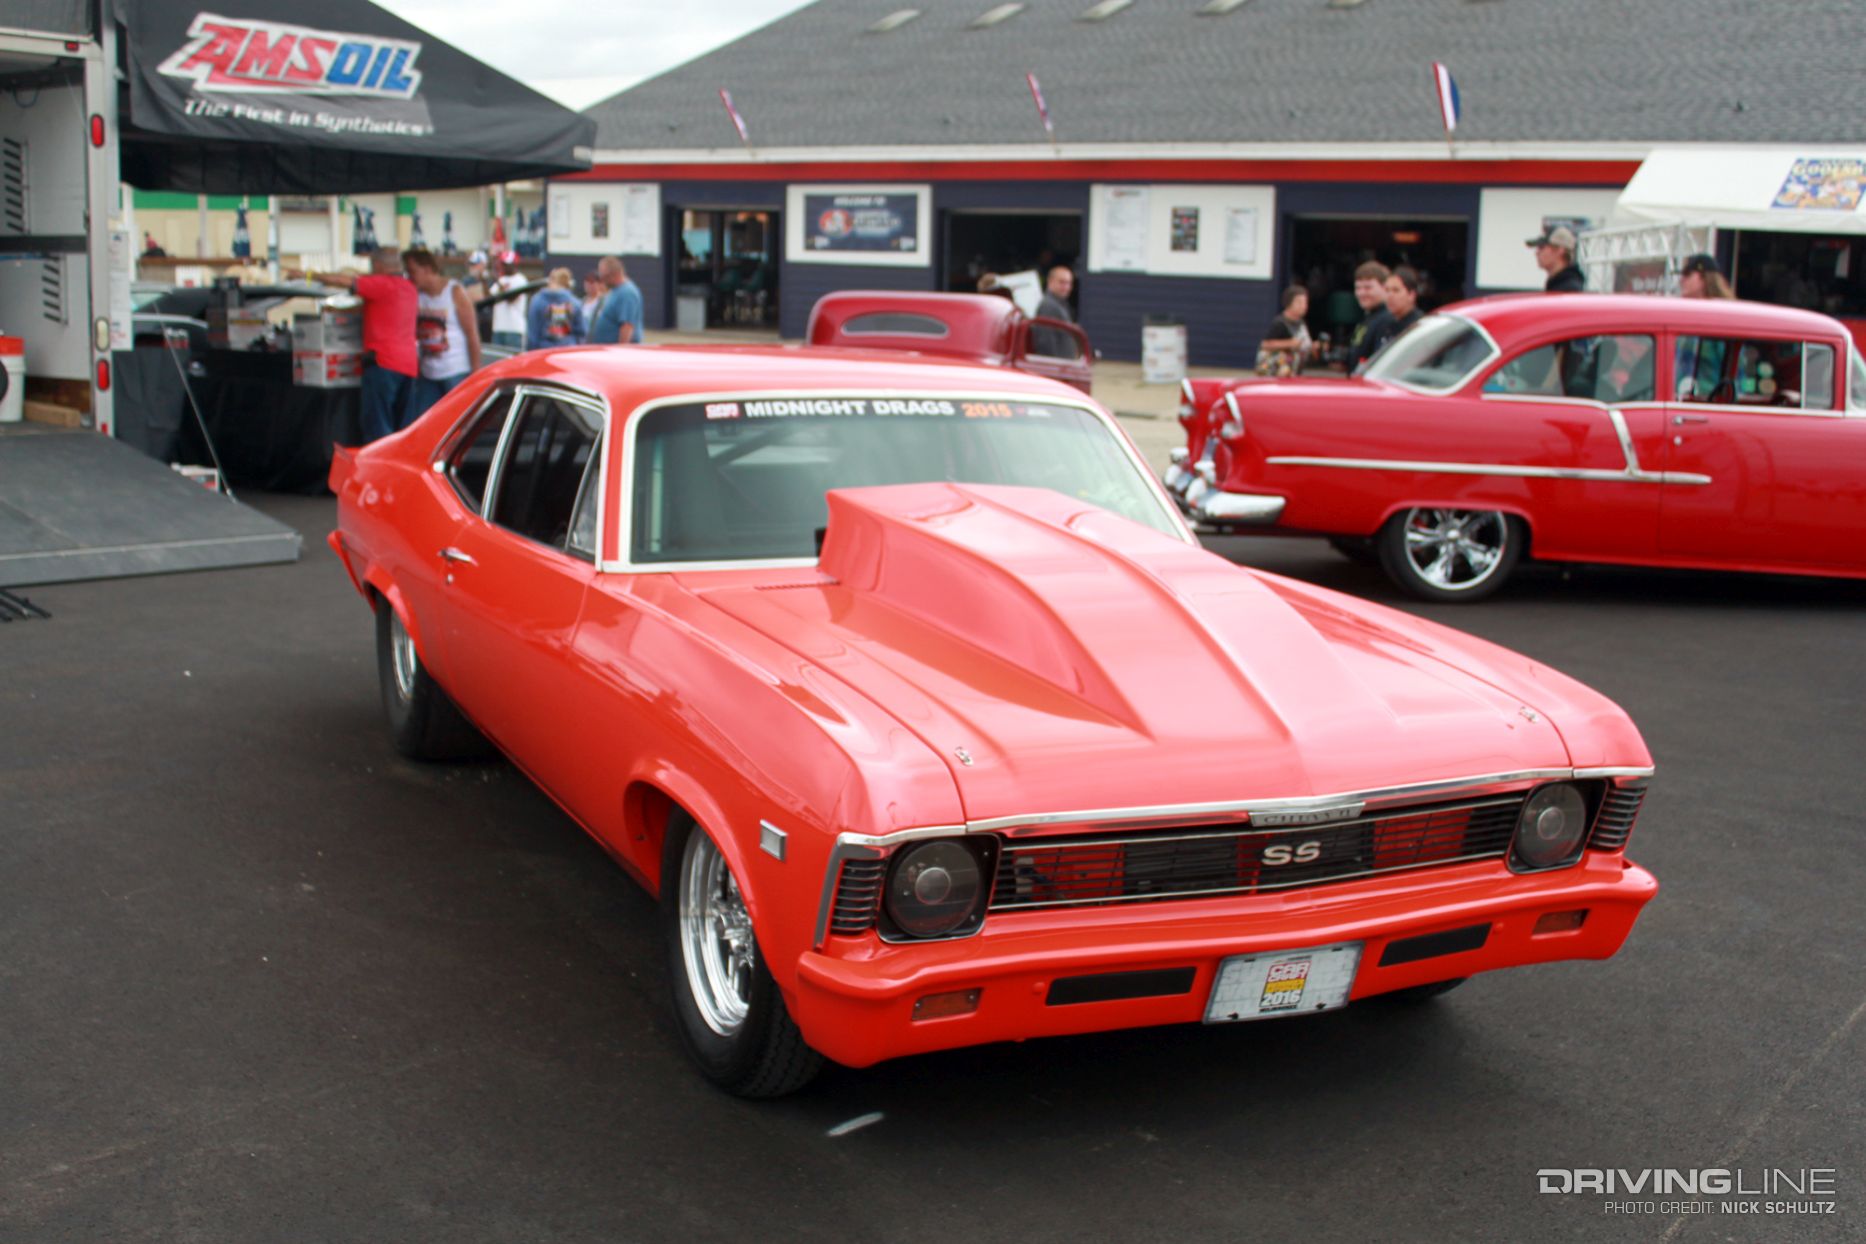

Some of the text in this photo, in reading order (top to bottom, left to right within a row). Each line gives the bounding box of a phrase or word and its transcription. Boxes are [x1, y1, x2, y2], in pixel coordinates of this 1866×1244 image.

[175, 20, 414, 94] AMSOIL
[185, 99, 423, 136] The First in Synthetics
[744, 401, 866, 417] MIDNIGHT
[871, 400, 955, 416] DRAGS
[1261, 841, 1321, 866] SS
[1260, 990, 1301, 1007] 2016
